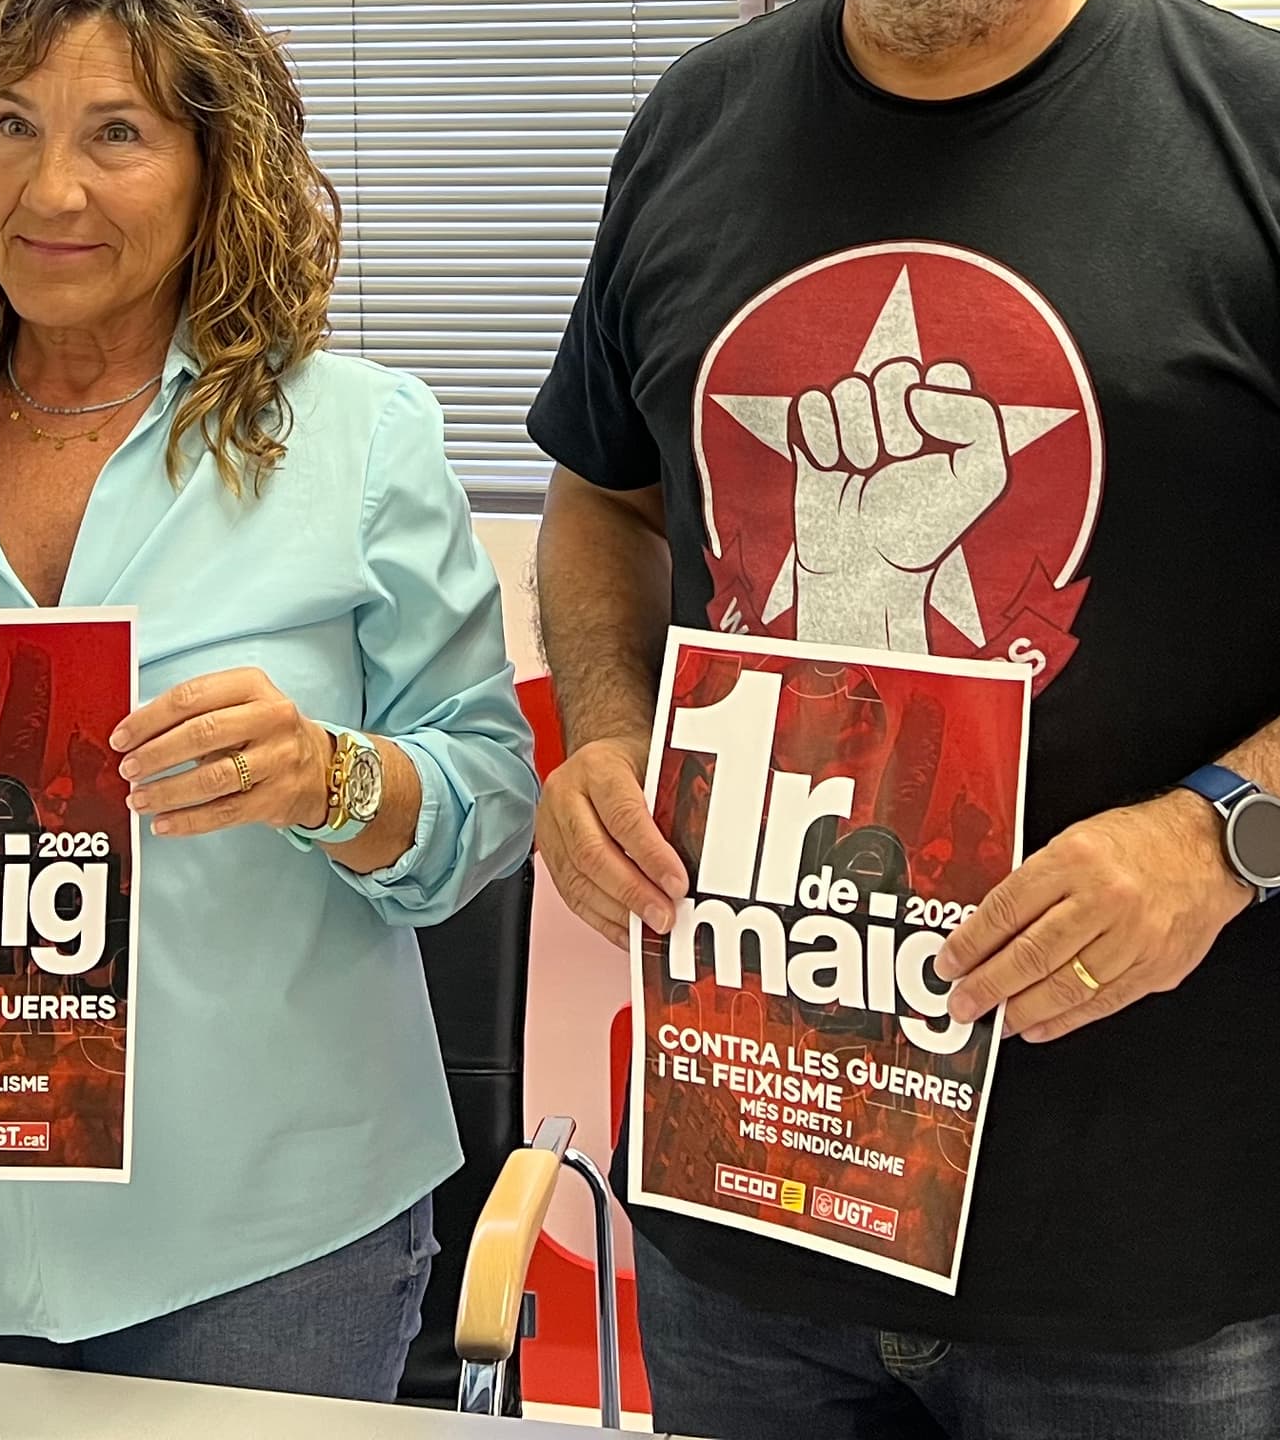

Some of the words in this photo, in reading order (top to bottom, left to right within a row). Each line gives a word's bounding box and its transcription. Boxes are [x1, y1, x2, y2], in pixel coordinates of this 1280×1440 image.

[669, 667, 855, 906] 1r
[798, 865, 860, 915] de
[38, 831, 110, 858] 2026
[667, 891, 975, 1055] maig
[658, 1024, 781, 1069] CONTRA
[788, 1049, 840, 1081] LES
[846, 1057, 974, 1112] GUERRES
[658, 1052, 666, 1078] I
[672, 1056, 706, 1085] EL
[712, 1062, 843, 1113] FEIXISME
[740, 1097, 779, 1122] MÉS
[782, 1108, 842, 1136] DRETS
[845, 1119, 852, 1138] I
[739, 1120, 779, 1145] MÉS
[781, 1131, 905, 1177] SINDICALISME
[720, 1170, 777, 1200] CCOO
[833, 1197, 894, 1236] UGT.cat
